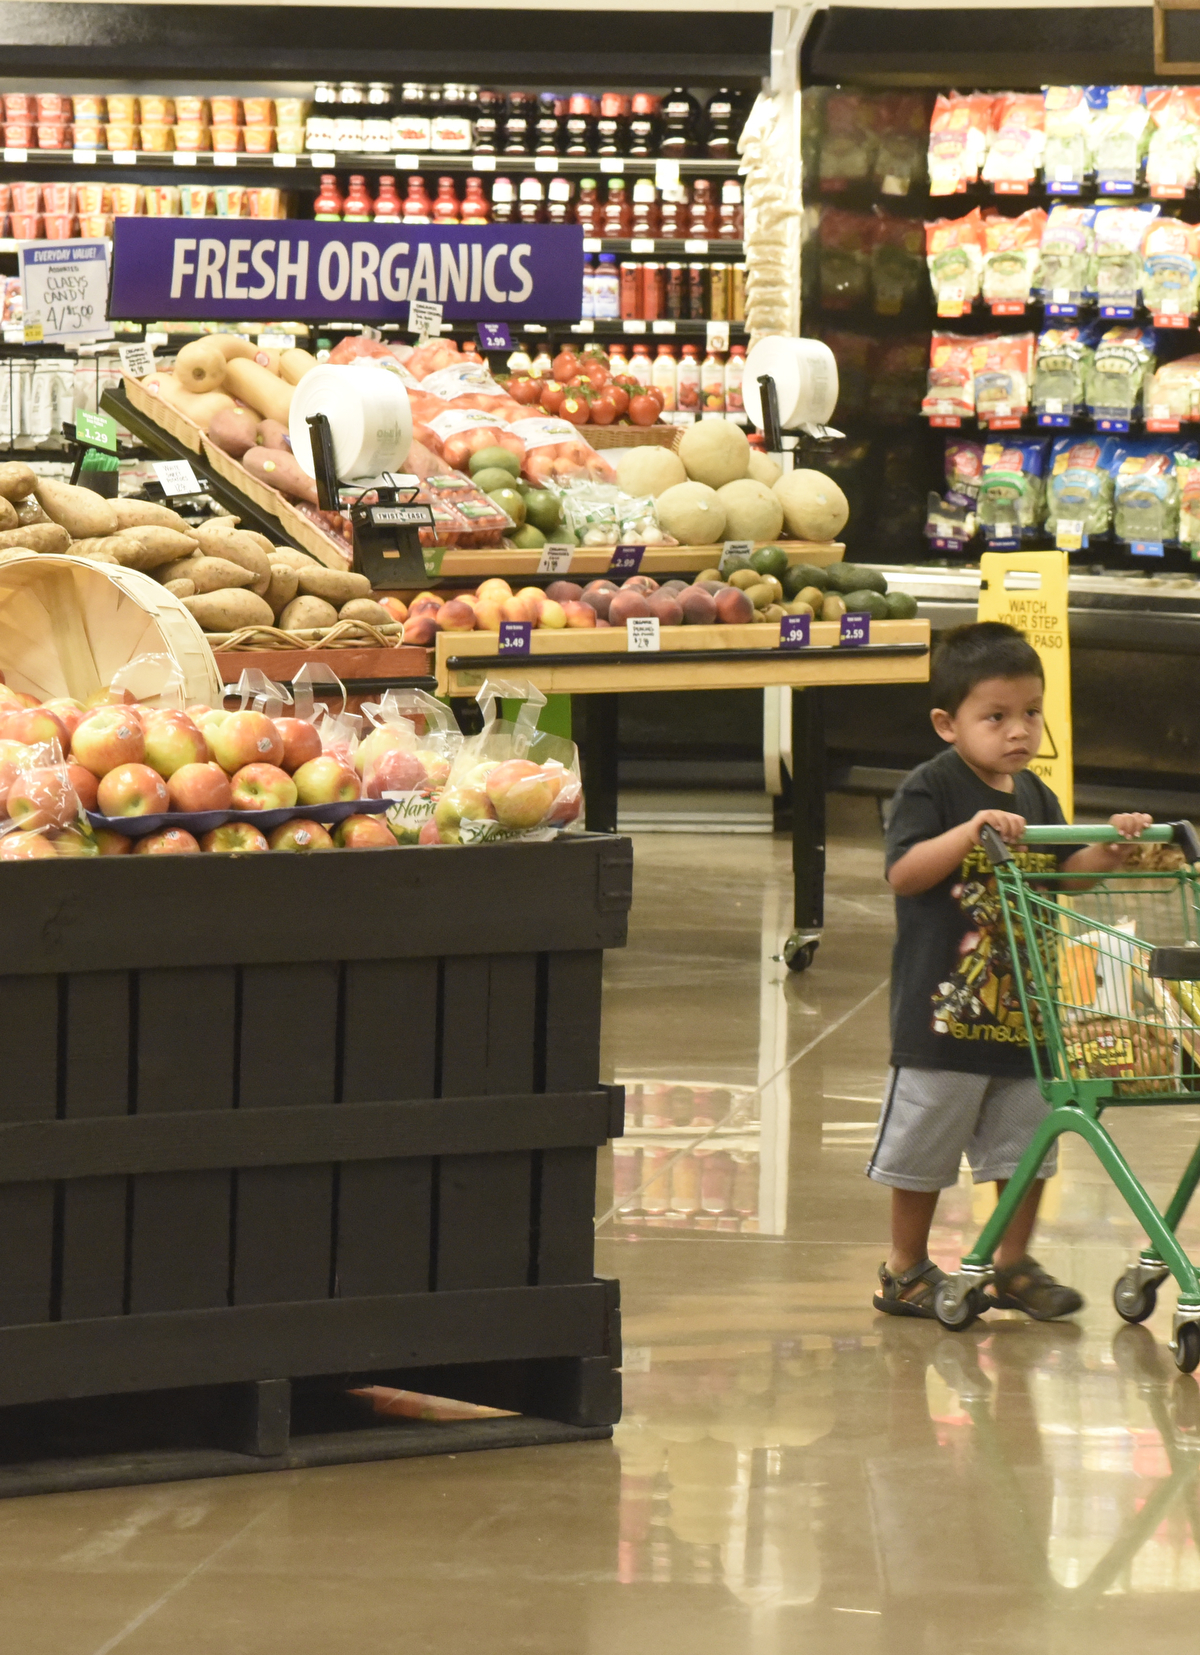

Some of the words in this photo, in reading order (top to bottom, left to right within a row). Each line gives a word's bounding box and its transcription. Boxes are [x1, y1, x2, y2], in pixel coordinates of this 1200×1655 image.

[34, 249, 71, 263] EVERYDAY
[72, 247, 97, 260] VALUE!
[170, 238, 309, 299] FRESH
[319, 240, 533, 303] ORGANICS
[43, 288, 86, 304] CANDY
[486, 337, 506, 347] 2.99
[84, 429, 108, 444] 1.29
[615, 558, 636, 568] 2.99
[1009, 600, 1047, 613] WATCH
[998, 614, 1028, 628] YOUR
[1031, 615, 1058, 630] STEP
[786, 629, 803, 642] .99
[845, 628, 864, 640] 2.59
[504, 637, 524, 648] 3.49
[1034, 635, 1063, 649] PASO
